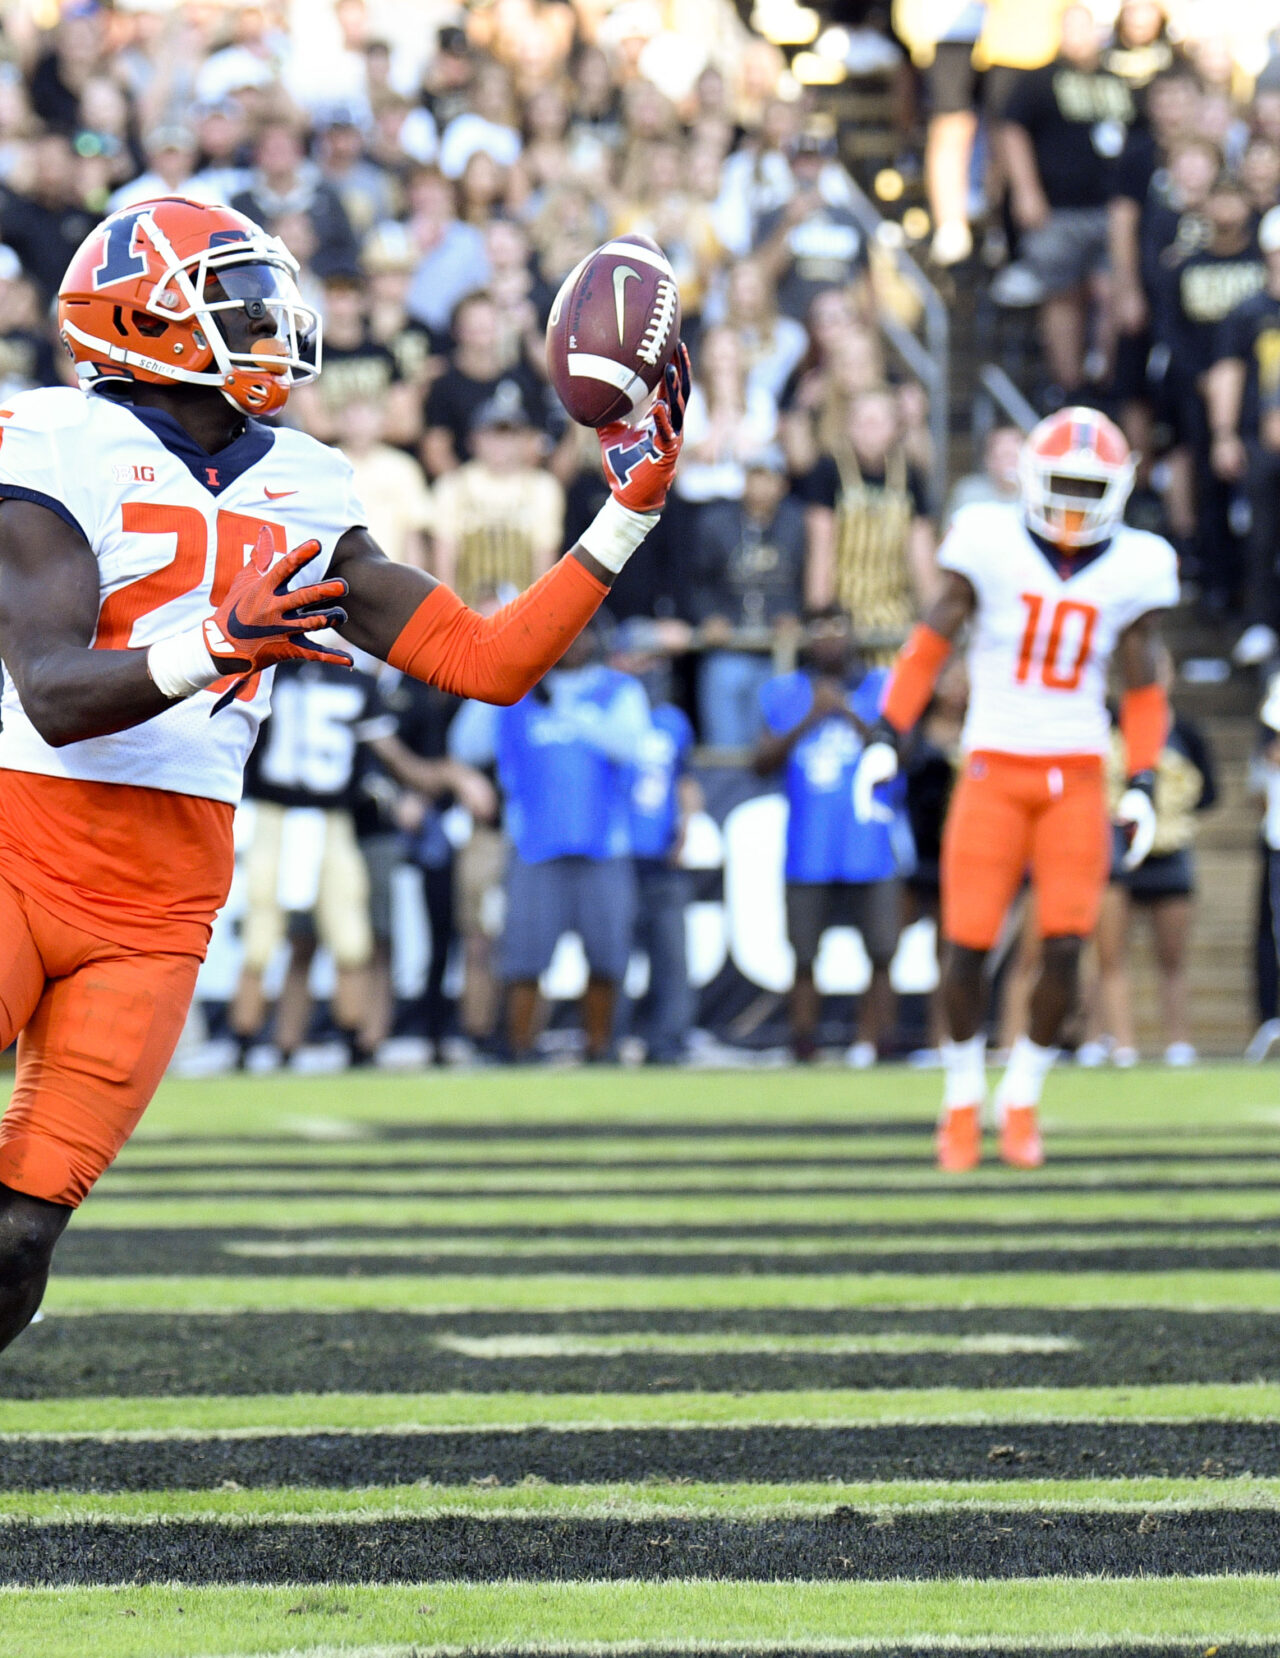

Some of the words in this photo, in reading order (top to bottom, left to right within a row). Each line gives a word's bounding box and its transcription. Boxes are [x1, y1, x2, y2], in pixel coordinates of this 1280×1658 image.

[139, 358, 176, 375] schu
[1016, 592, 1099, 691] 10
[260, 680, 365, 796] 15
